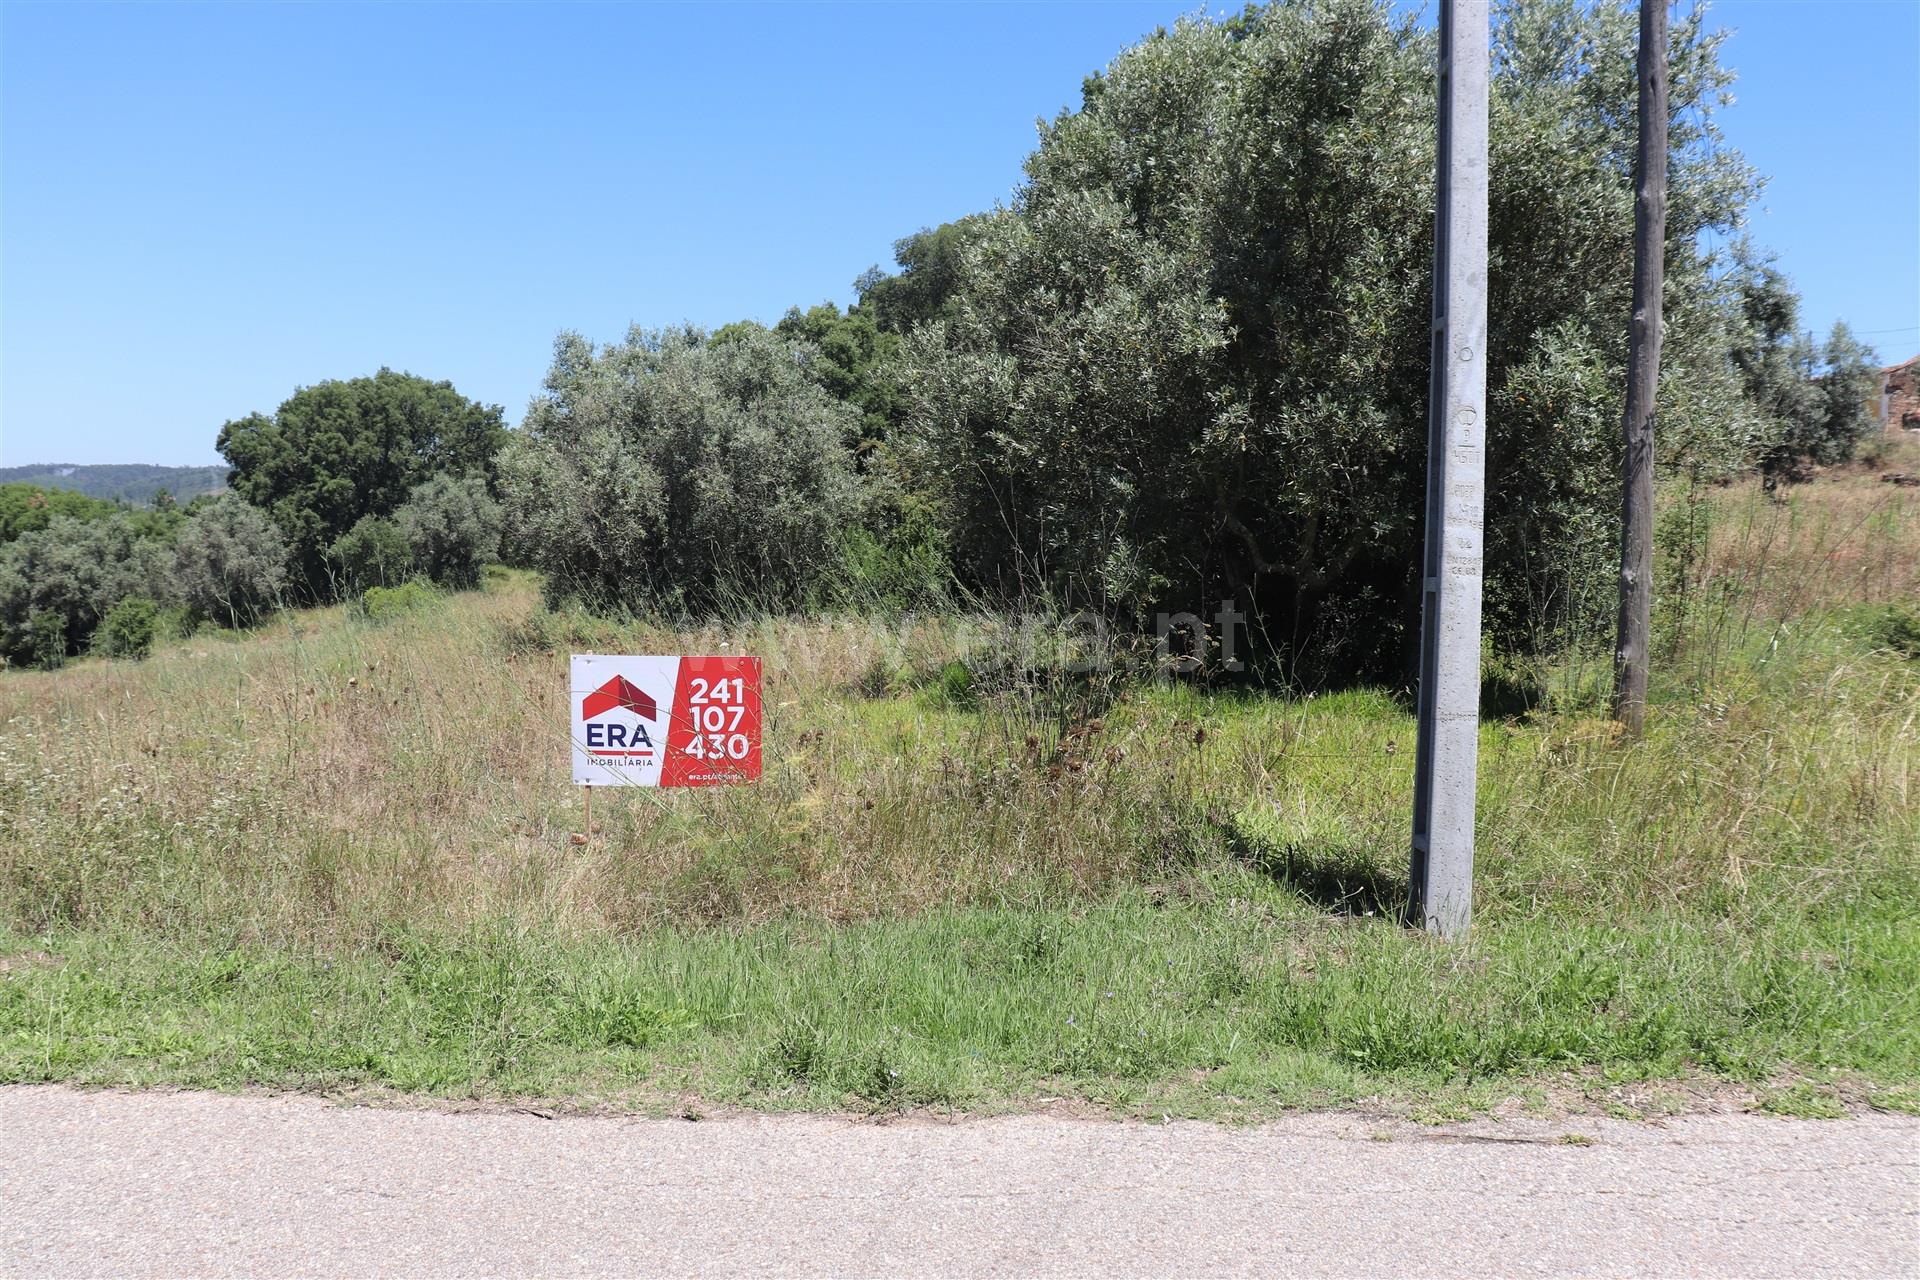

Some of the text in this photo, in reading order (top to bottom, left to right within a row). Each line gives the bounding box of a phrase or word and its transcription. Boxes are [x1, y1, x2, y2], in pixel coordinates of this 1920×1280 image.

[690, 678, 744, 704] 241
[689, 706, 745, 732] 107
[586, 723, 653, 748] ERA
[685, 733, 749, 760] 430
